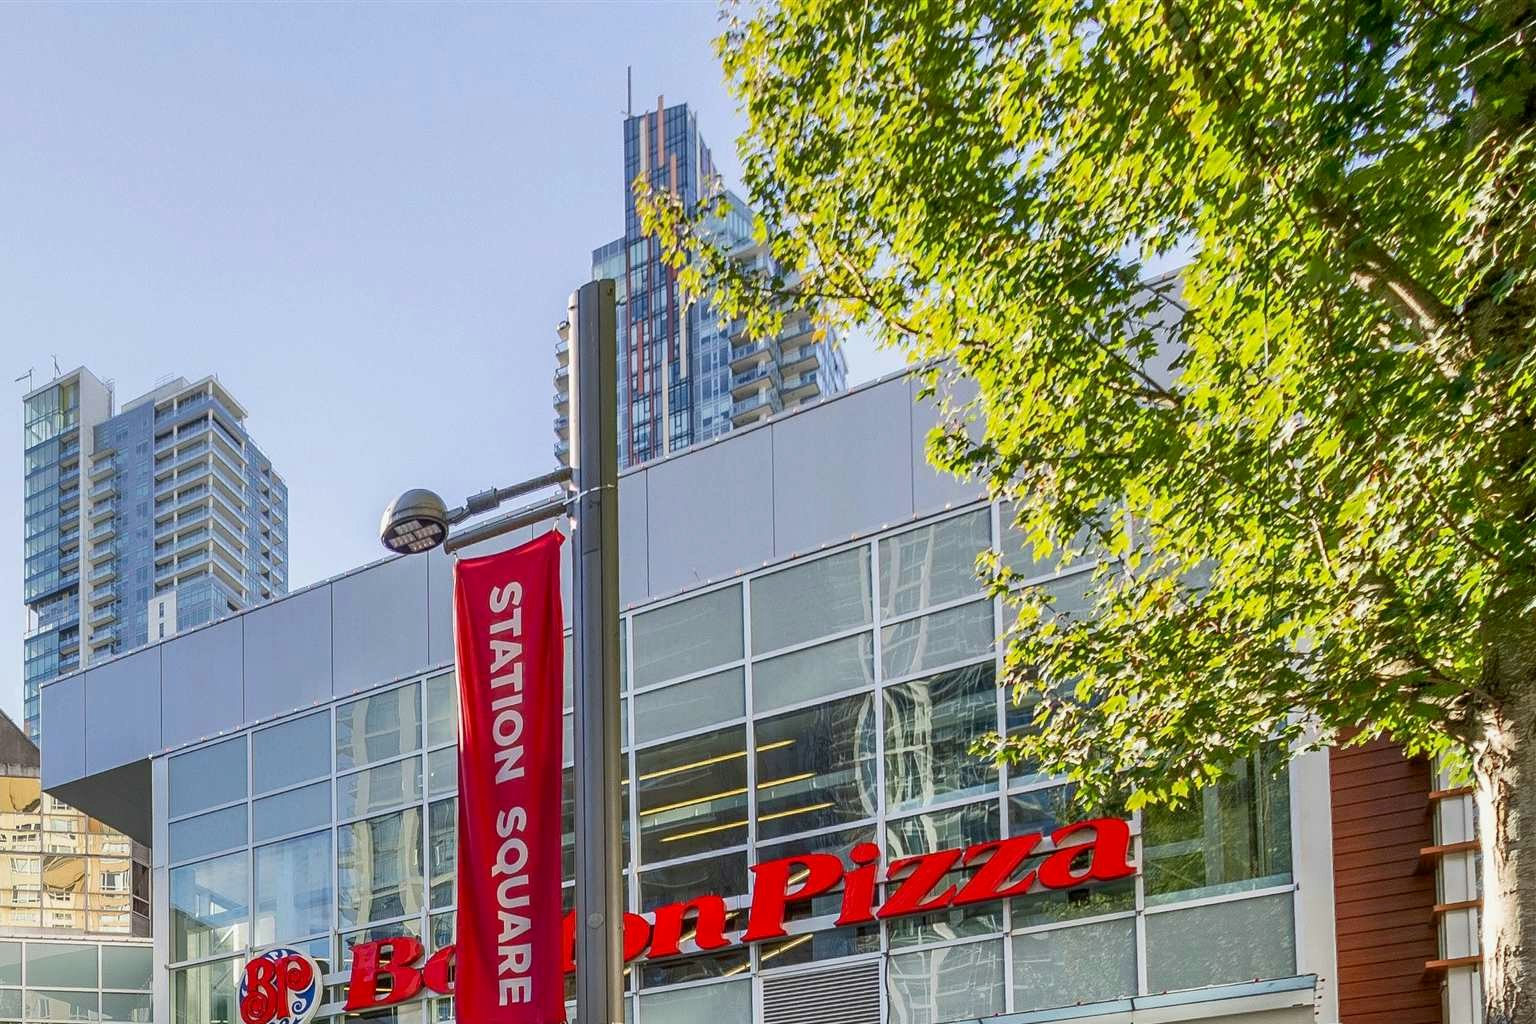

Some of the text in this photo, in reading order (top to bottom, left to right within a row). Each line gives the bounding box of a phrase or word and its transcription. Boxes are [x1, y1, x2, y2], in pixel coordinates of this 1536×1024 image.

[488, 580, 533, 1007] STATION SQUARE
[740, 816, 1137, 943] Pizza
